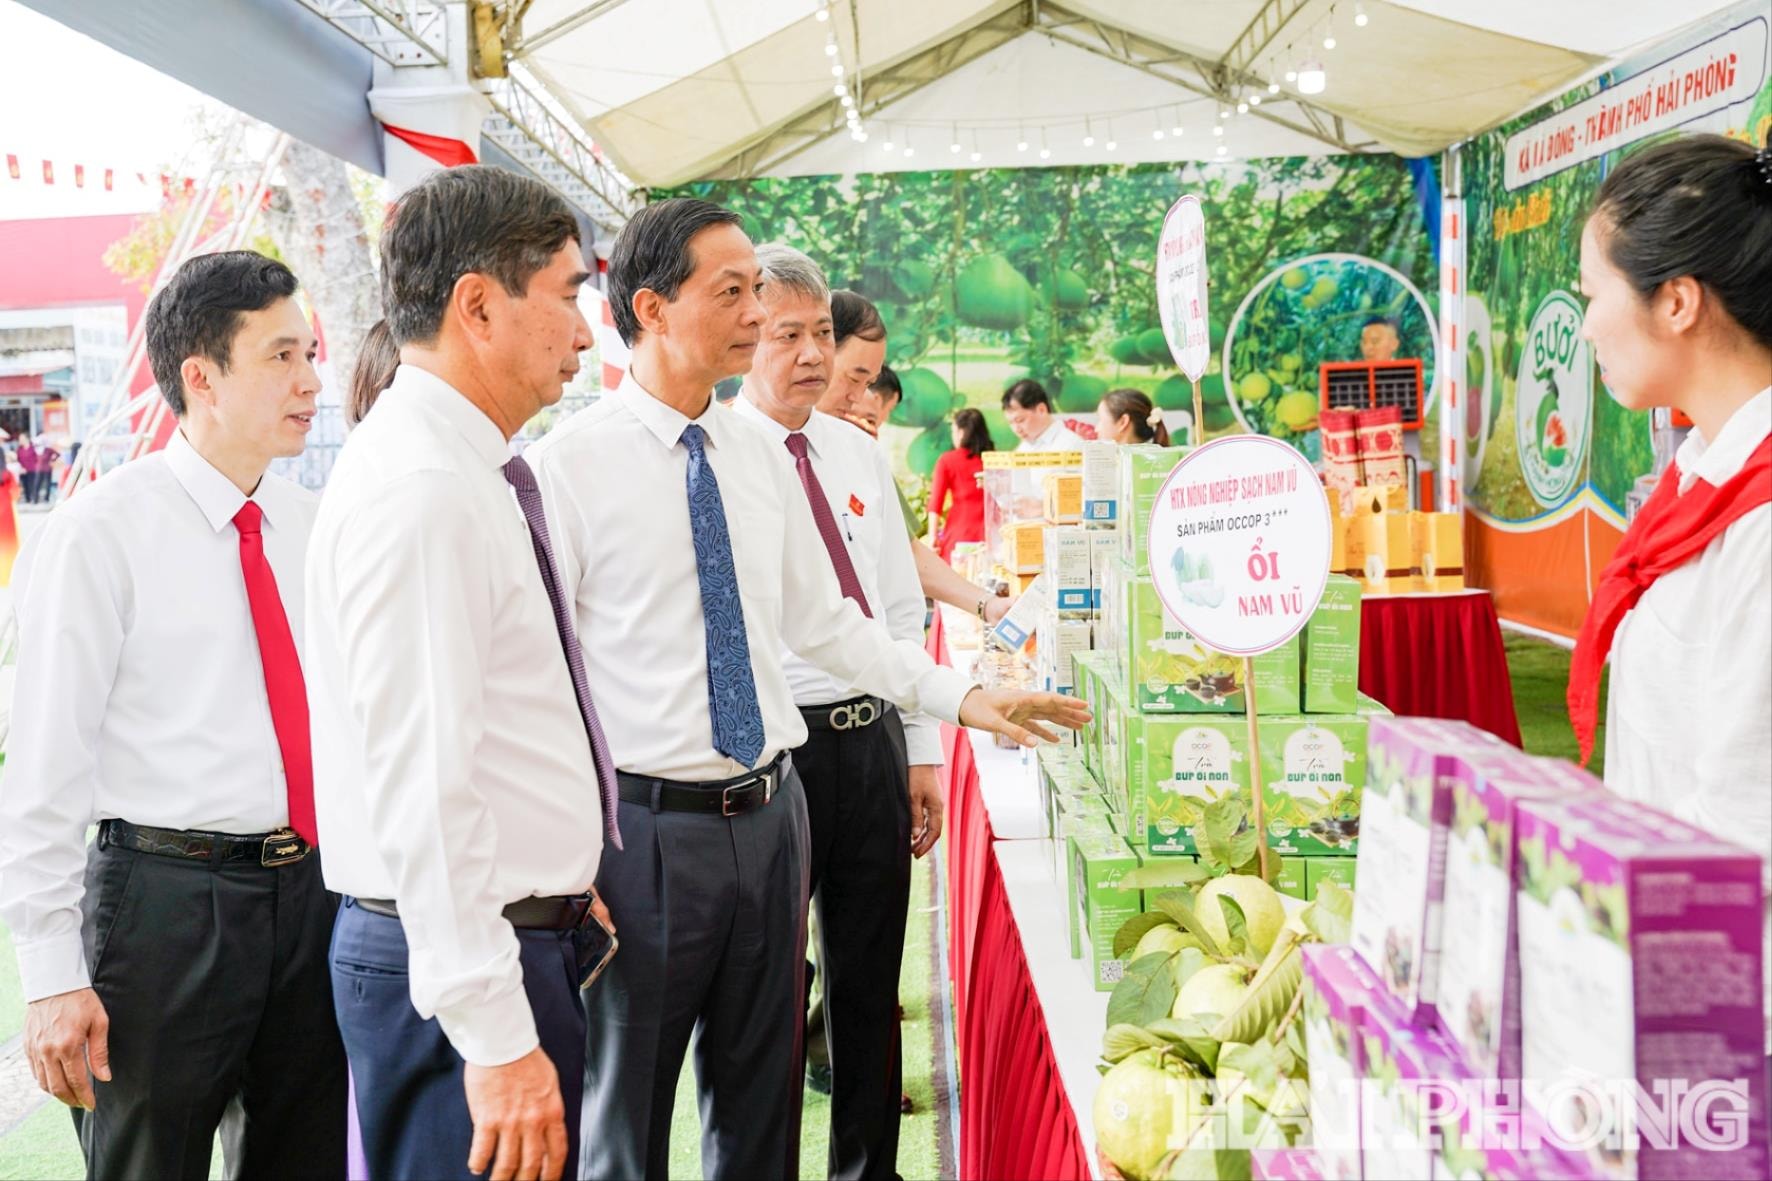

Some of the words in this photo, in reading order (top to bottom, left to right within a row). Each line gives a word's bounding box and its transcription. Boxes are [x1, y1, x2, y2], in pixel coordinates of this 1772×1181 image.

[1625, 77, 1655, 129] PHỐ
[1656, 68, 1680, 118] HẢI
[1170, 486, 1186, 510] HTX
[1187, 481, 1208, 507] NÔNG
[1209, 474, 1239, 507] NGHIỆP
[1241, 475, 1264, 504] SẠCH
[1265, 470, 1285, 496] NAM
[1177, 517, 1196, 537] SẢN
[1198, 510, 1225, 534] PHẨM
[1227, 513, 1262, 531] OCCOP
[1247, 536, 1281, 582] ỔI
[1238, 594, 1273, 616] NAM
[1280, 586, 1303, 616] VŨ
